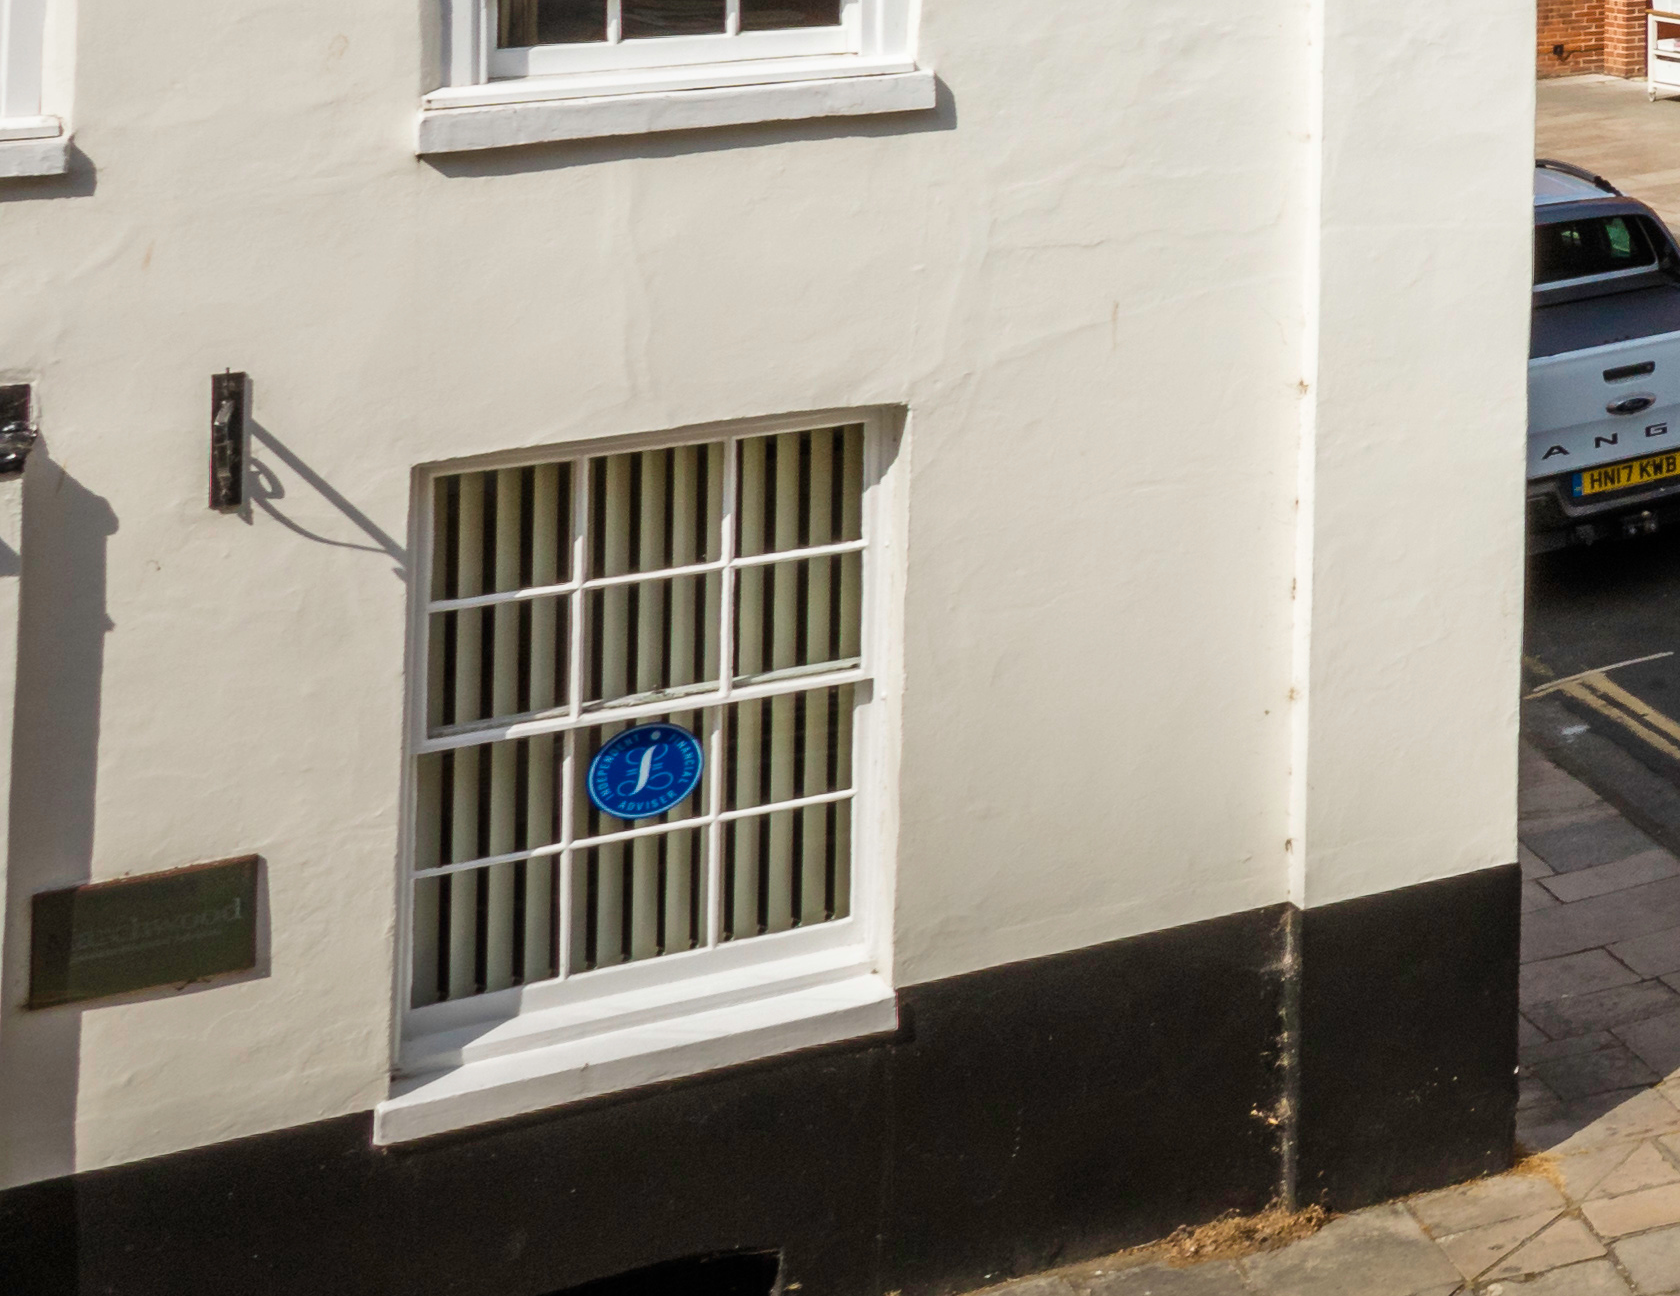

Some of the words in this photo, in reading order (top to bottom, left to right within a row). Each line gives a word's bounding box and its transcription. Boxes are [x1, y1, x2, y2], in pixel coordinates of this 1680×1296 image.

[1590, 466, 1633, 490] HN17
[1640, 456, 1677, 480] KWB
[596, 734, 639, 801] INDEPENDENT
[668, 734, 695, 784] FINANCIAL
[618, 790, 678, 810] ADVISER
